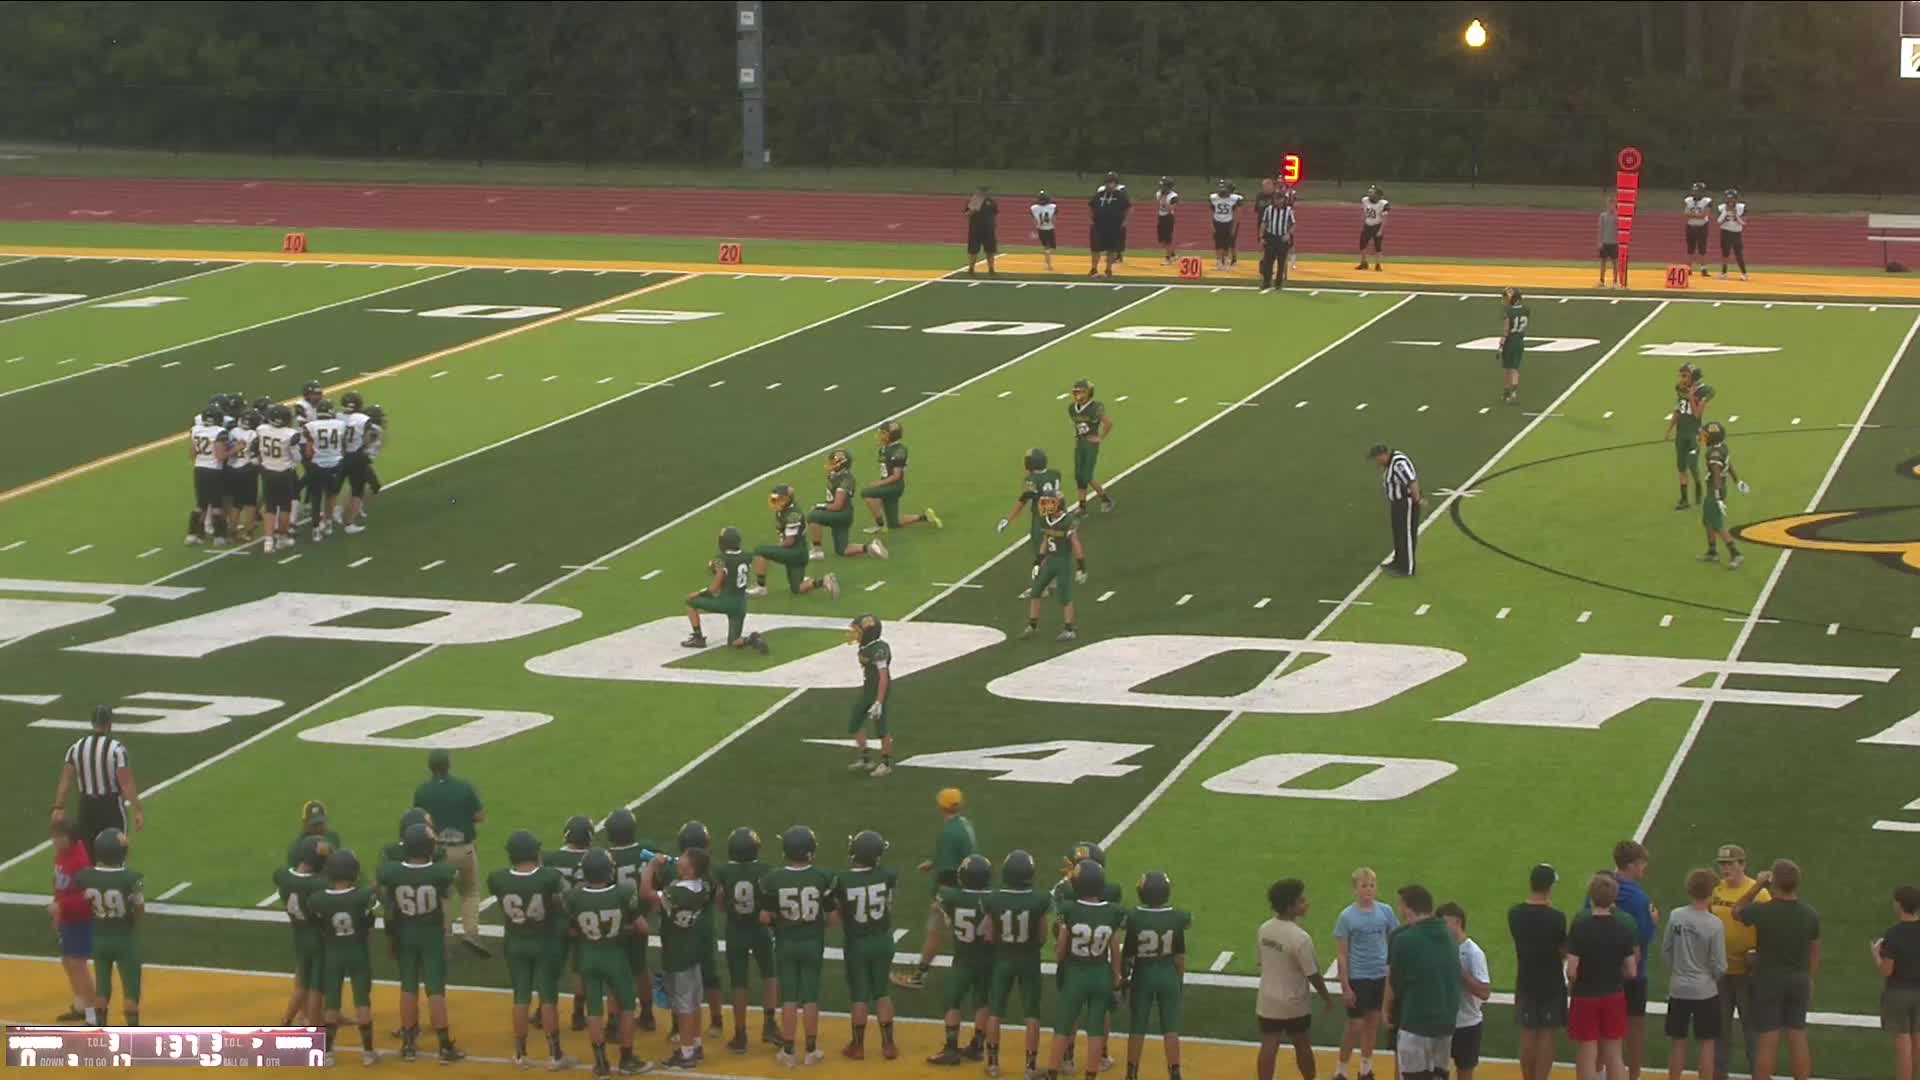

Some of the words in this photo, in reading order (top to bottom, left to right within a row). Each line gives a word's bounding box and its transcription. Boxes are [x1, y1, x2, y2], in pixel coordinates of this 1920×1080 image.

[1284, 155, 1298, 181] 3
[1216, 203, 1230, 215] 55
[721, 244, 738, 262] 20
[1180, 258, 1199, 275] 30
[1668, 267, 1685, 285] 40
[1511, 316, 1528, 333] 12
[194, 436, 212, 456] 32
[263, 436, 281, 458] 56
[317, 428, 339, 450] 54
[395, 885, 437, 916] 60
[503, 894, 545, 924] 64
[734, 880, 755, 914] 9
[778, 886, 820, 921] 56
[847, 882, 887, 923] 75
[578, 909, 622, 940] 87
[1000, 910, 1030, 943] 11
[1136, 929, 1174, 957] 21
